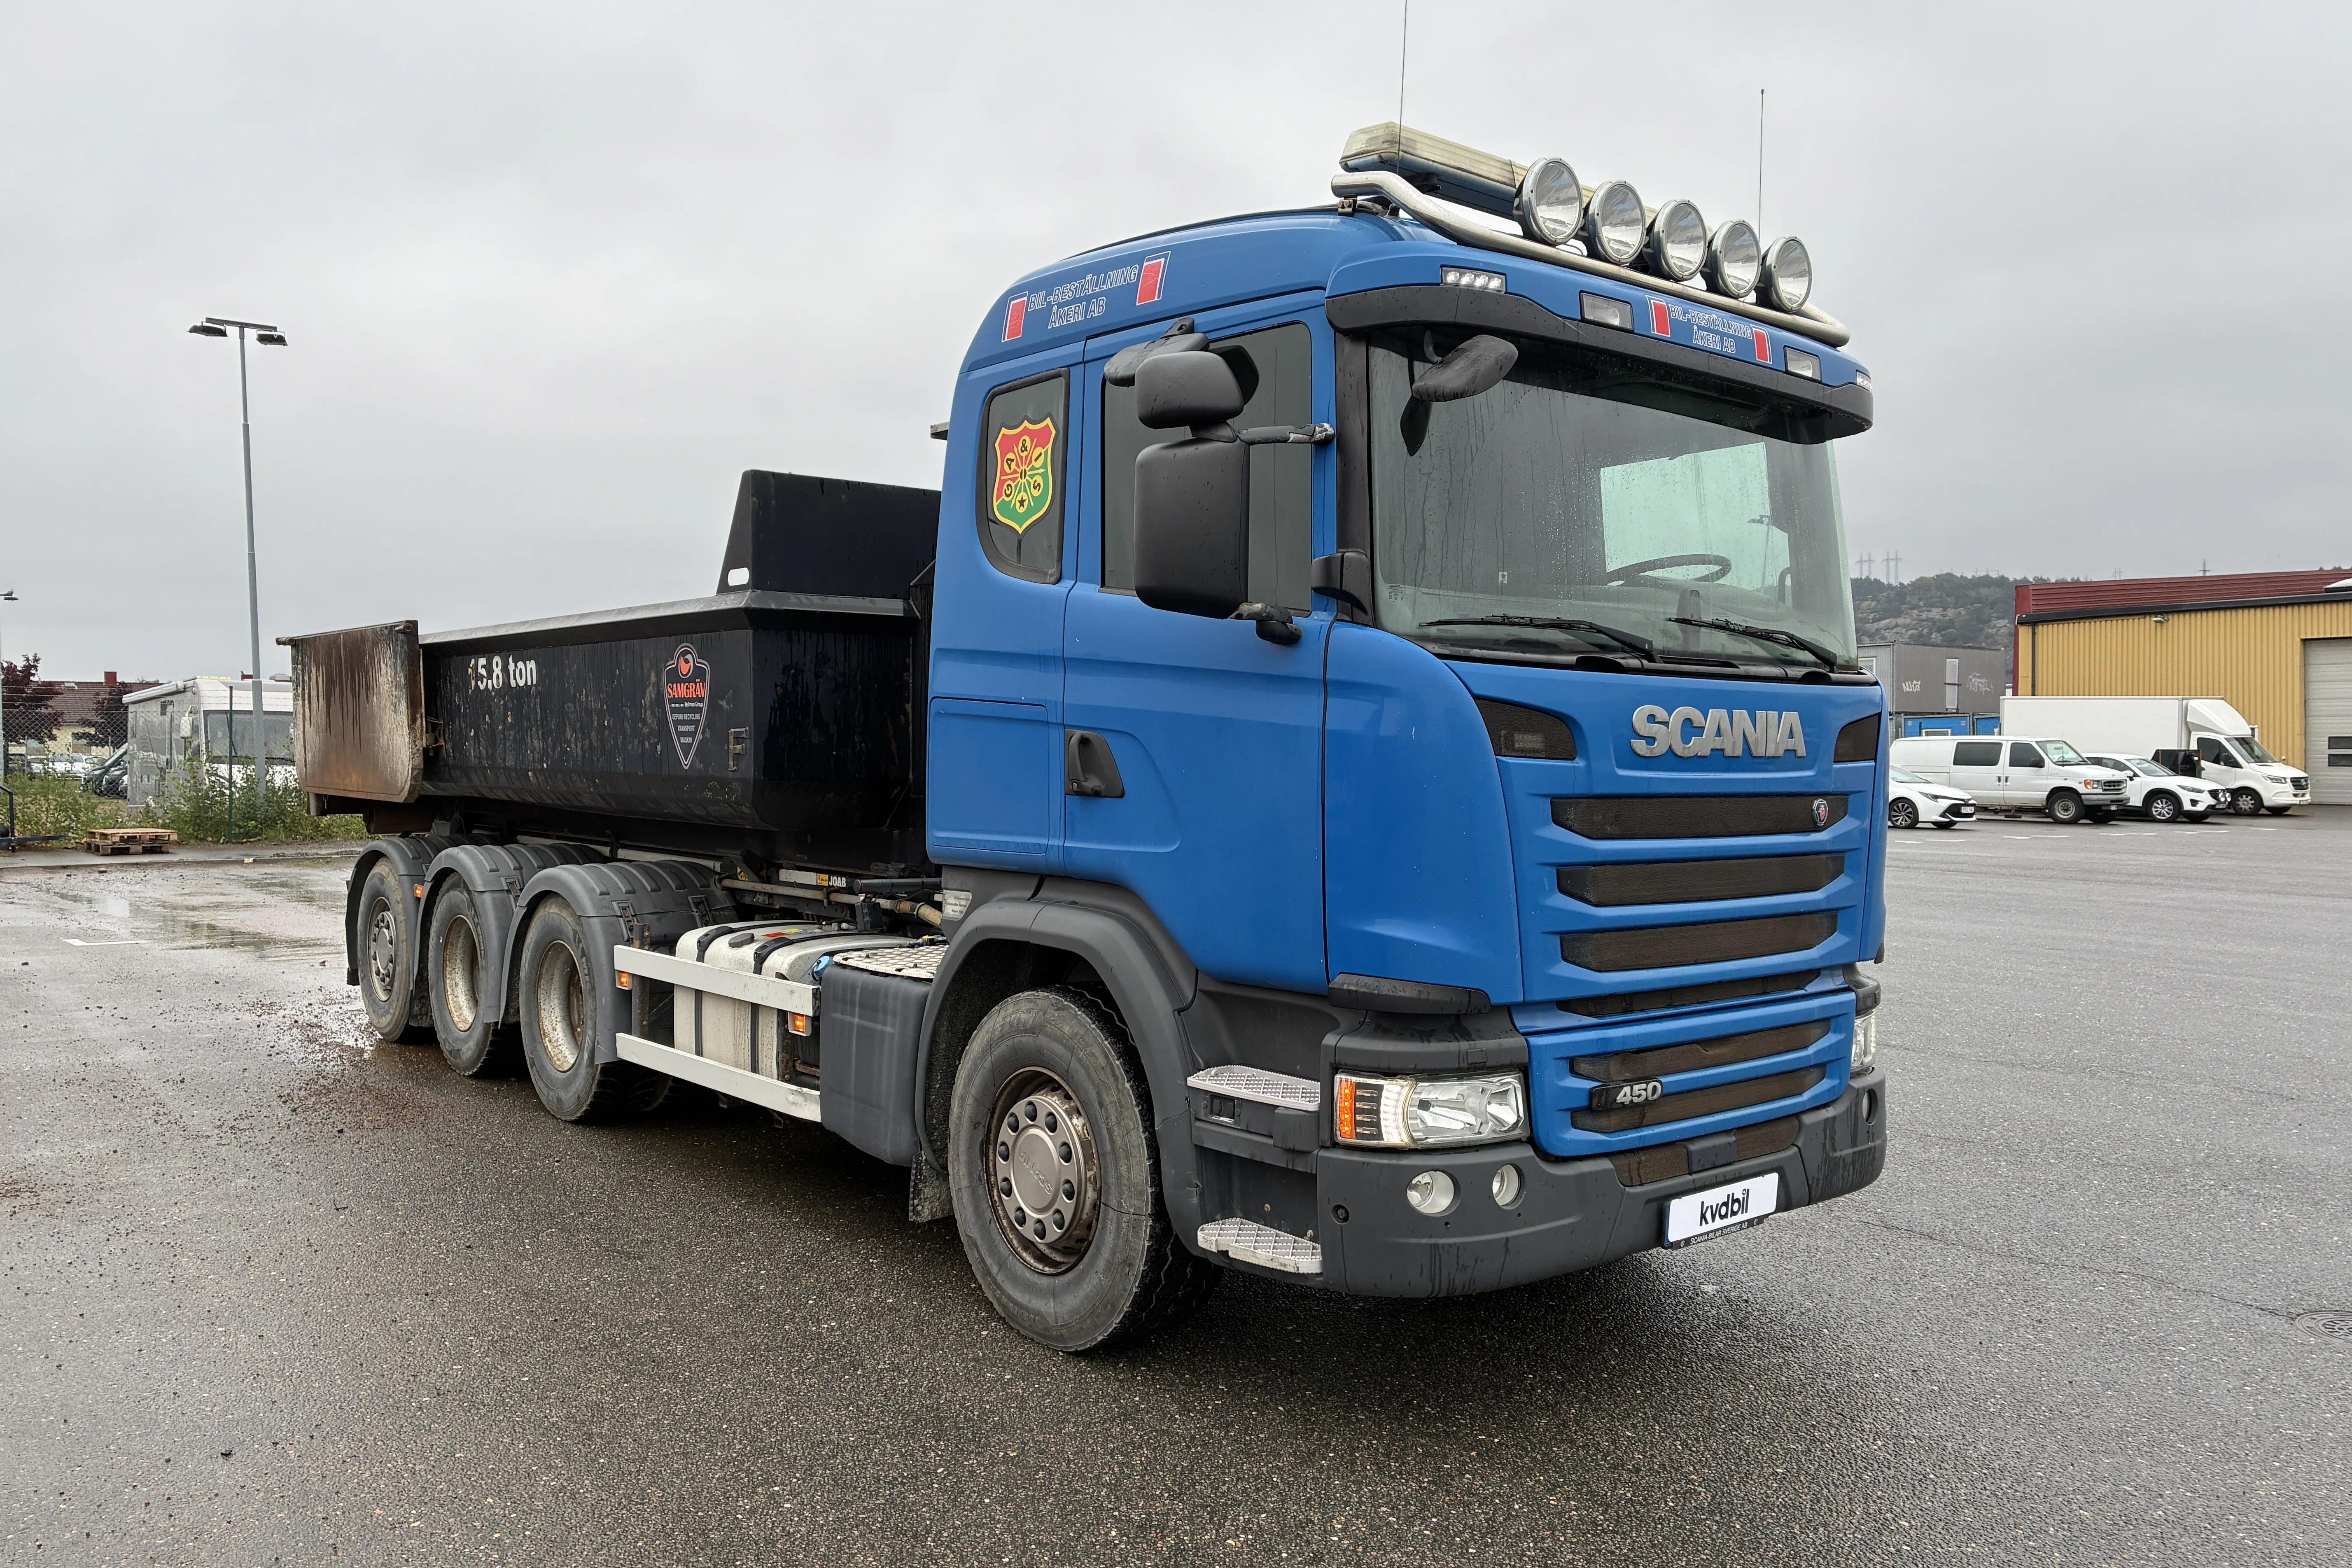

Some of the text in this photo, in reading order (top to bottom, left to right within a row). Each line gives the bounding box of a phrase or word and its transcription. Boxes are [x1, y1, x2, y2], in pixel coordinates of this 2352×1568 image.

[1028, 264, 1139, 312] BIL-BESTÄLLNING
[1048, 296, 1106, 329] ÅKERI AB
[1668, 304, 1752, 339] BIL-BESTÄLLNING
[1693, 325, 1736, 353] ÅKERI AB
[508, 654, 536, 687] ton
[667, 679, 705, 698] SAMGRÄV
[1631, 705, 1806, 758] SCANIA
[829, 876, 846, 887] JOAB
[1616, 1081, 1661, 1105] 450
[1699, 1188, 1750, 1227] kvdbil
[1722, 1224, 1741, 1235] SVERIGE
